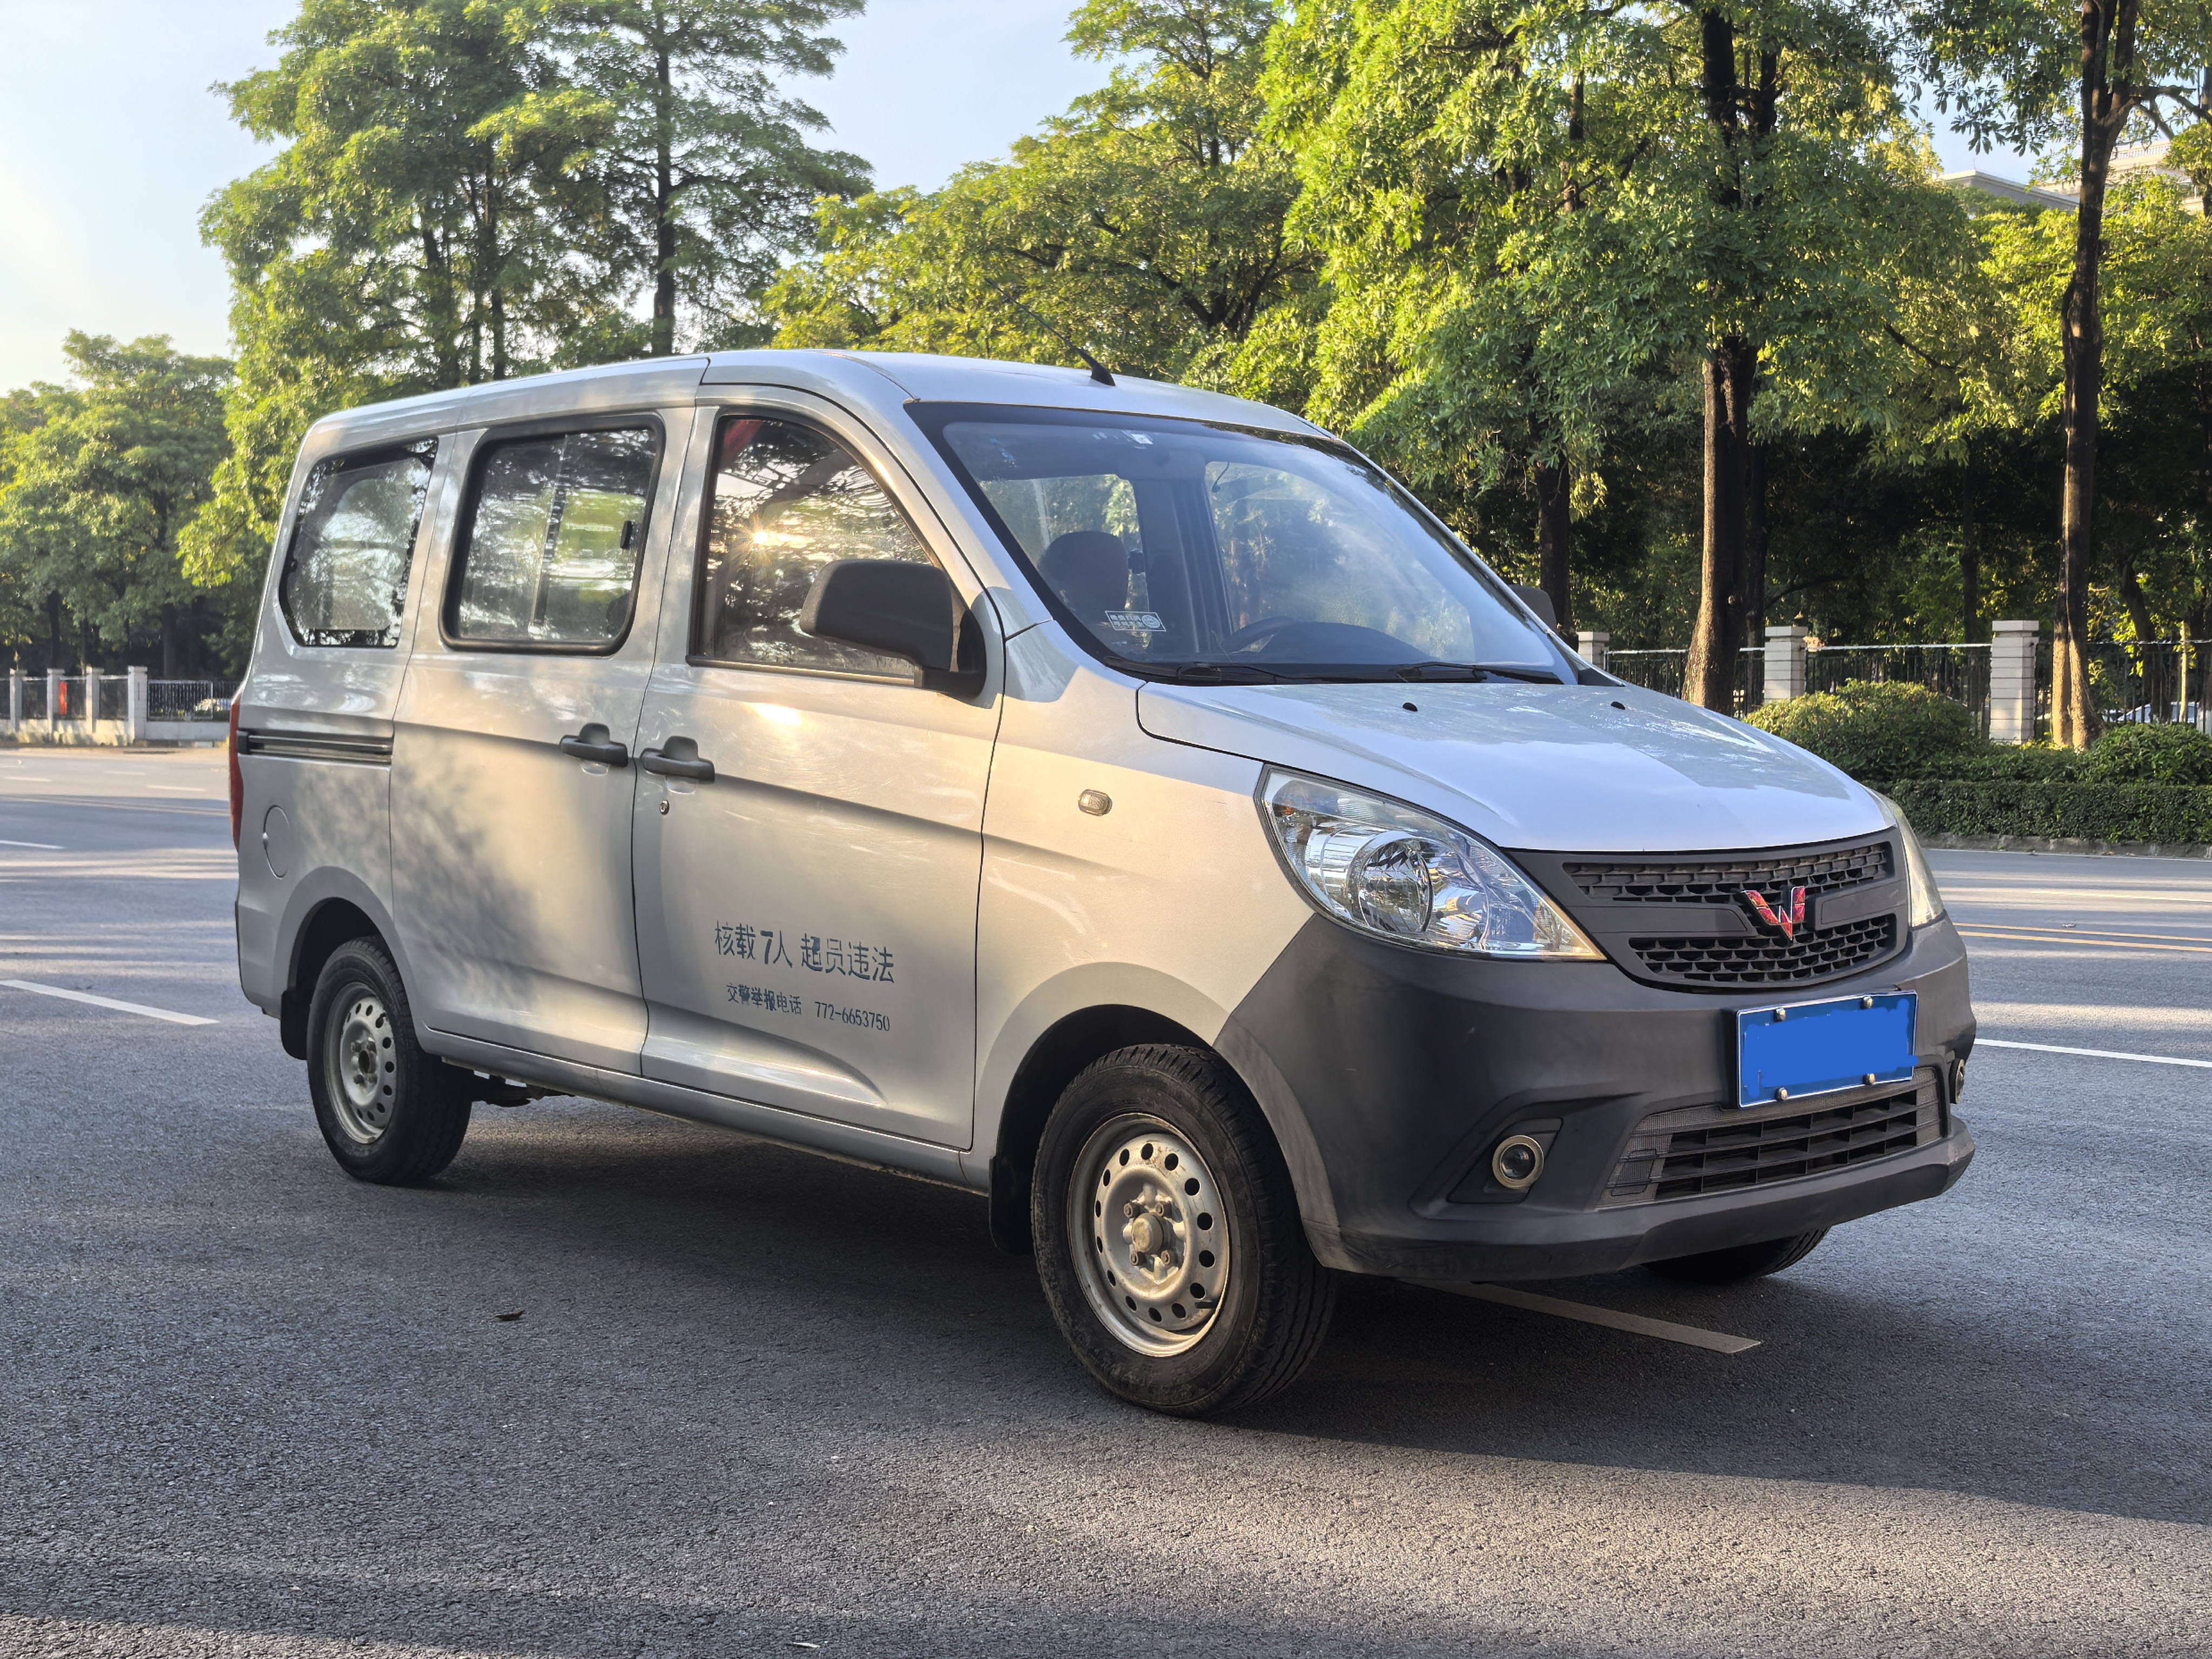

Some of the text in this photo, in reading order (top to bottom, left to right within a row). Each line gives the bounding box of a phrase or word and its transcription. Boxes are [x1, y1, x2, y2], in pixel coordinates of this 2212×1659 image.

[714, 920, 894, 983] 核载7人 超员违法
[726, 982, 890, 1031] 交警举报电话 772-6653750
